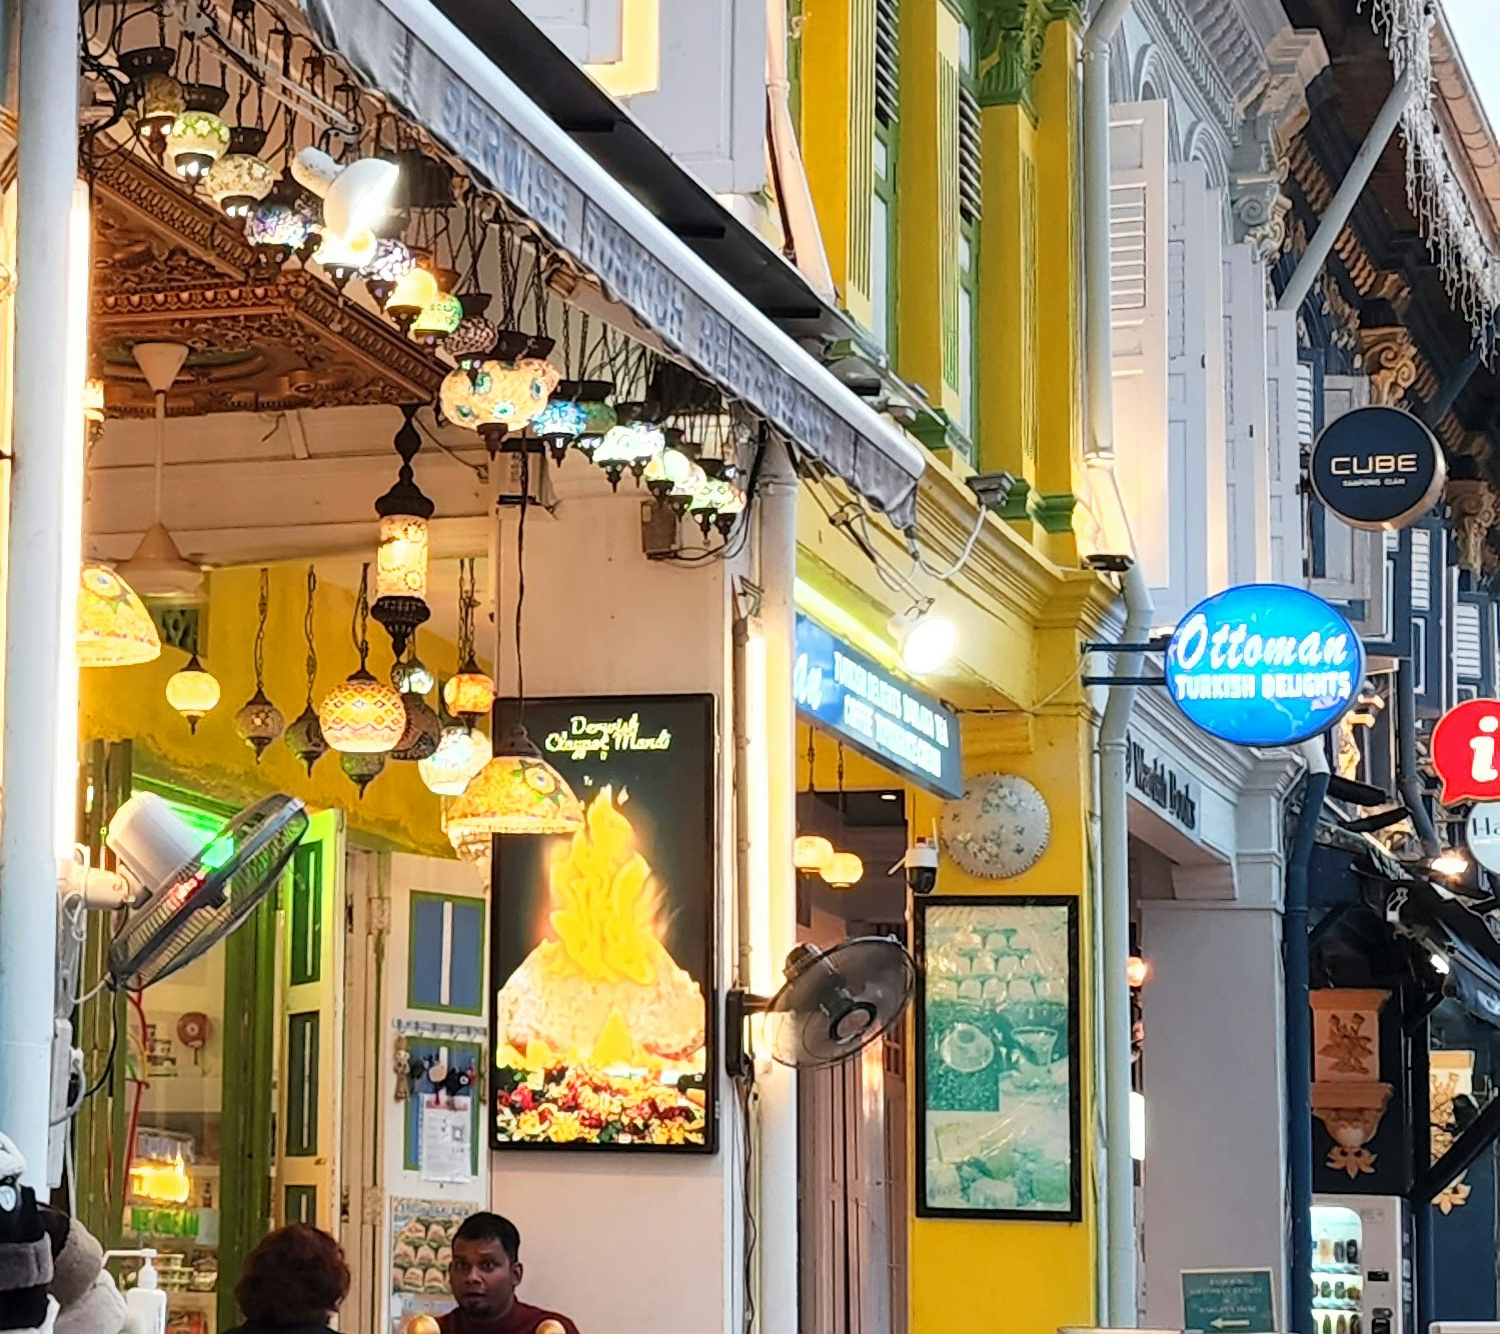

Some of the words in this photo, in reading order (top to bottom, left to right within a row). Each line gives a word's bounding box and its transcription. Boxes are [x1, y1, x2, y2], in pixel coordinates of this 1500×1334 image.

[1330, 453, 1418, 475] CUBE
[1176, 613, 1349, 671] Ottoman
[1174, 673, 1256, 700] TURKISH
[1261, 670, 1351, 700] DELIGHTS
